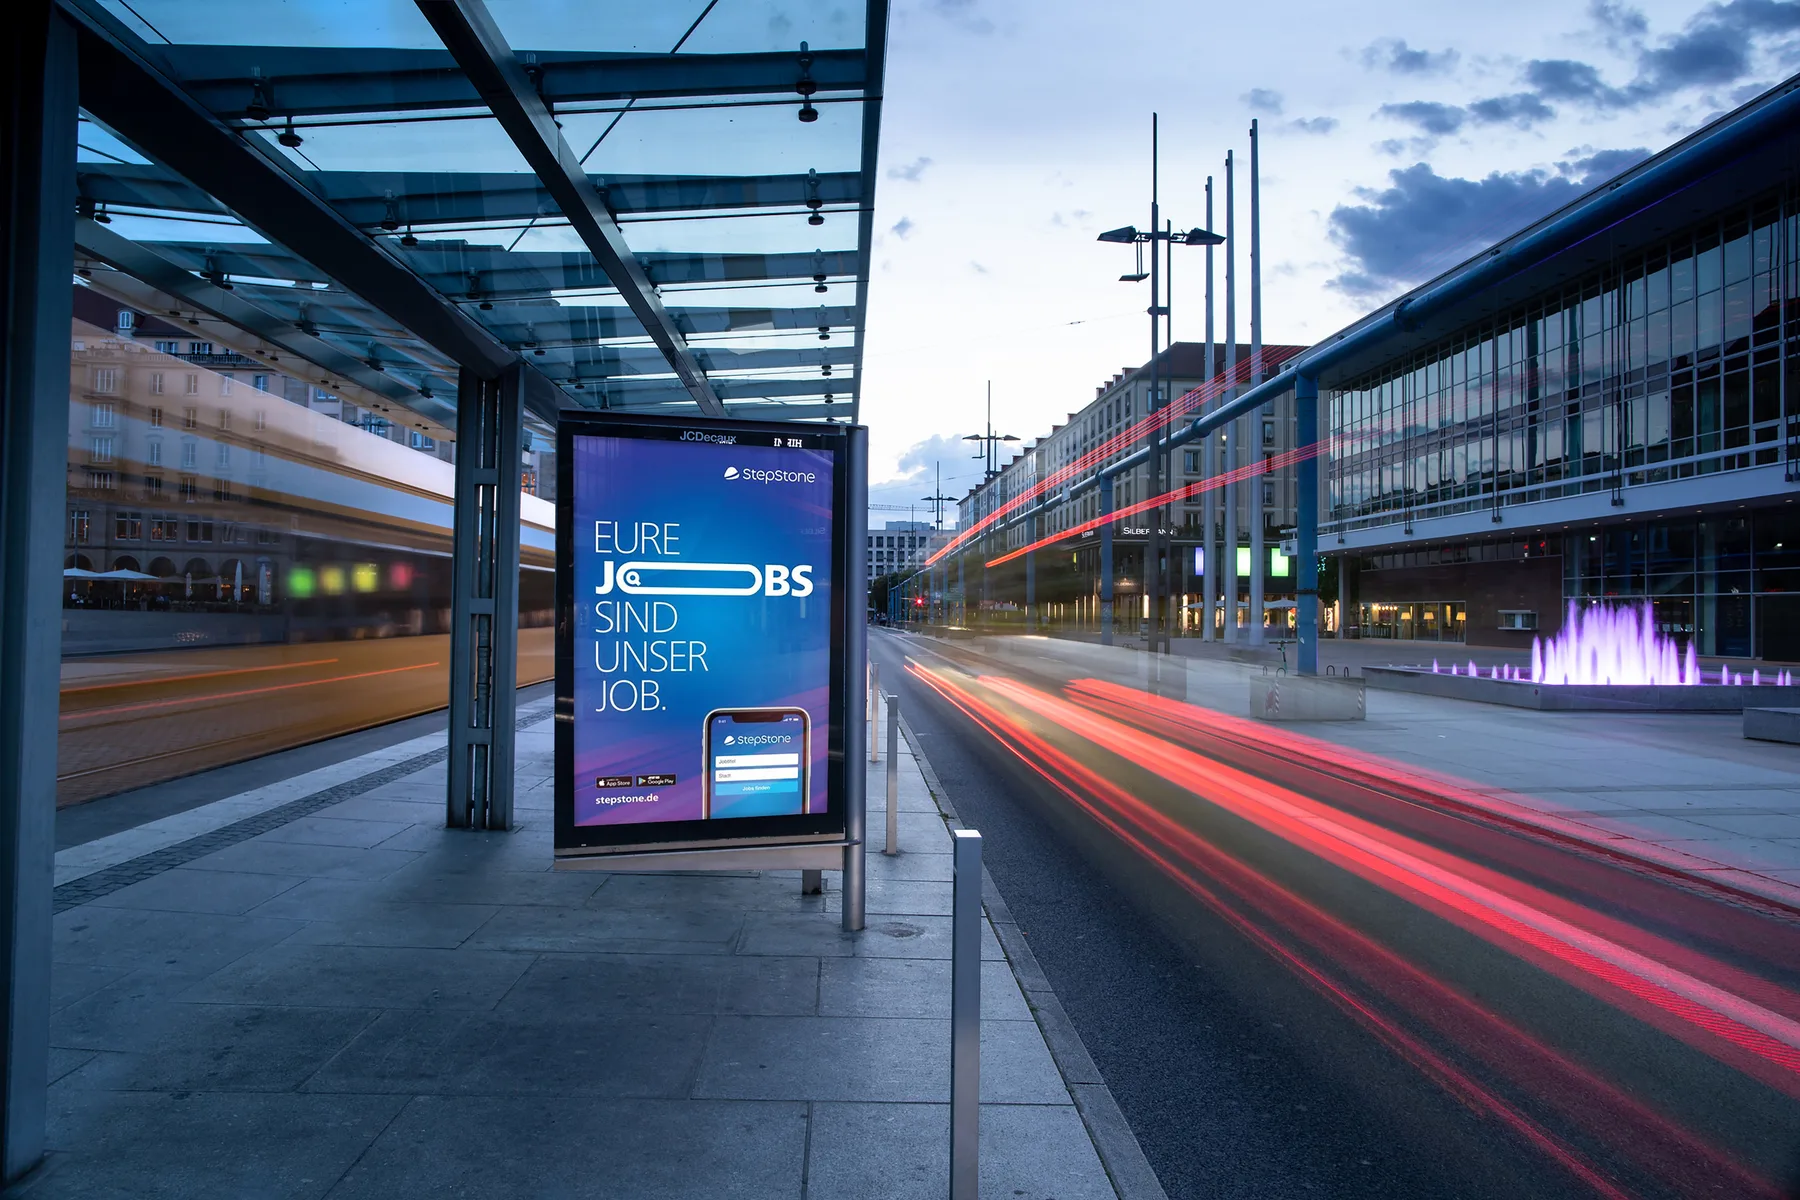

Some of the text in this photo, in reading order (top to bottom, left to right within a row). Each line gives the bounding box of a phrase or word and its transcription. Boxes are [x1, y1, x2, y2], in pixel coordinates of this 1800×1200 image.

[679, 430, 737, 444] JCDecaux
[742, 468, 816, 485] StepStone
[595, 520, 680, 555] EURE
[595, 600, 678, 634] SIND
[595, 640, 709, 673] UNSER
[595, 679, 666, 712] JOB.
[737, 734, 792, 747] StepStone
[595, 793, 659, 805] stepstone.de
